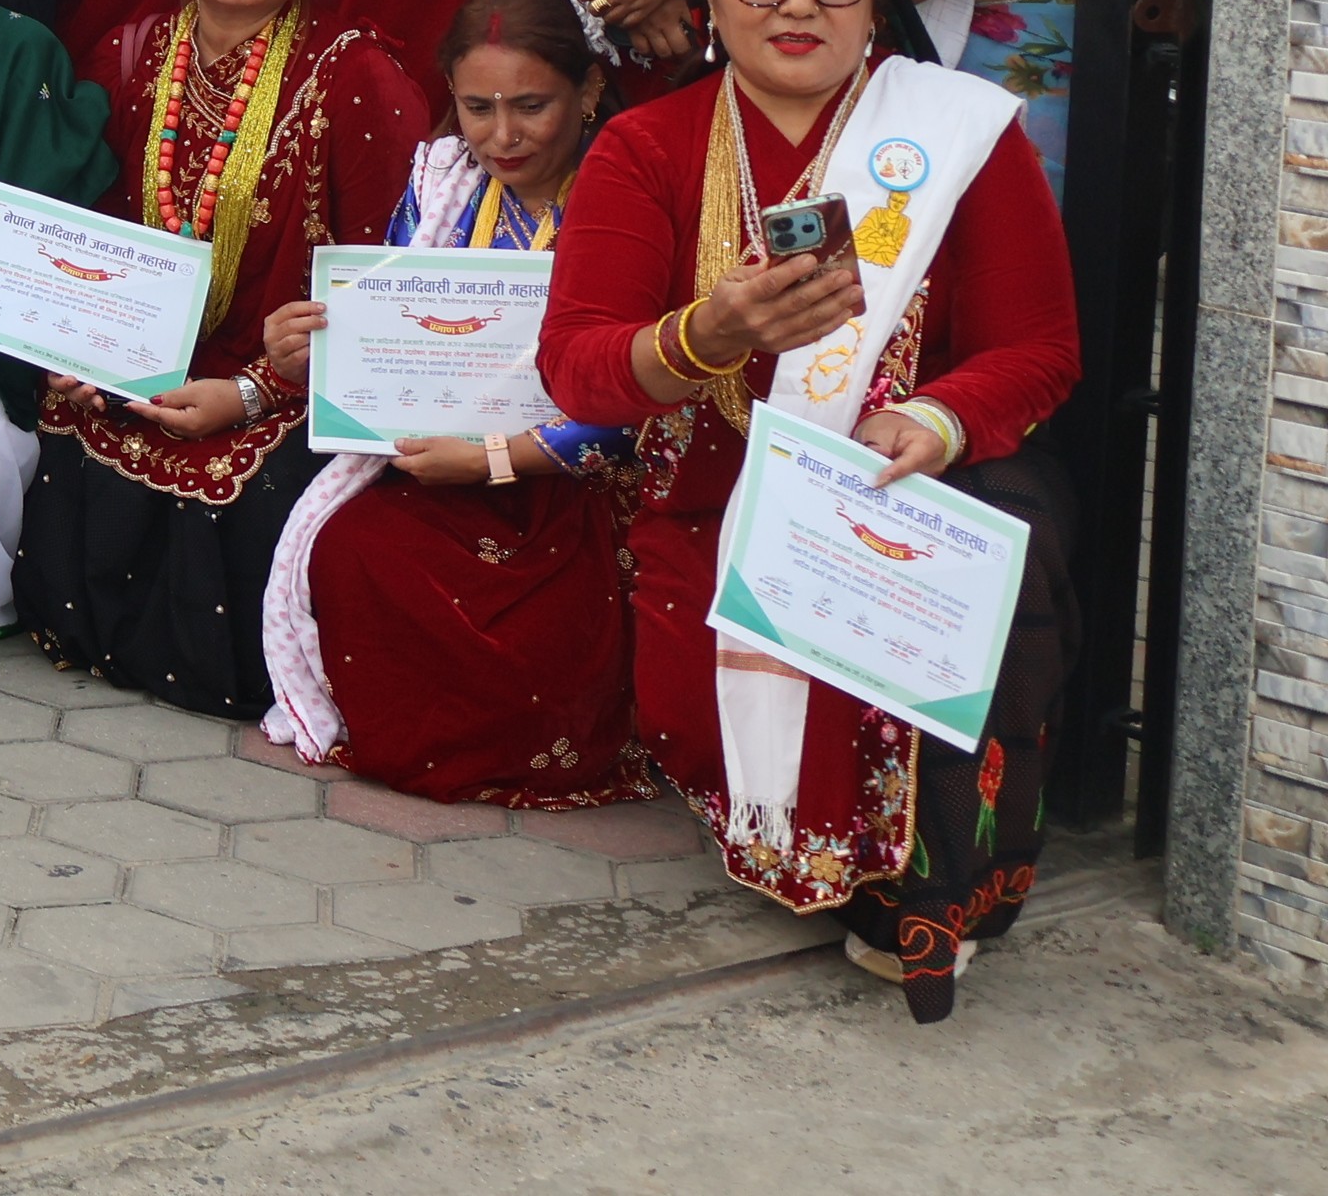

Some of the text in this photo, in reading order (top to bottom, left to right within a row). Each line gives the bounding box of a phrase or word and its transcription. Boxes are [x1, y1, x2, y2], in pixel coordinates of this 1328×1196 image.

[3, 210, 36, 230] नेपाल
[37, 222, 88, 247] आदिवासी
[136, 252, 178, 273] महासंघ
[395, 277, 451, 295] आदिवासी
